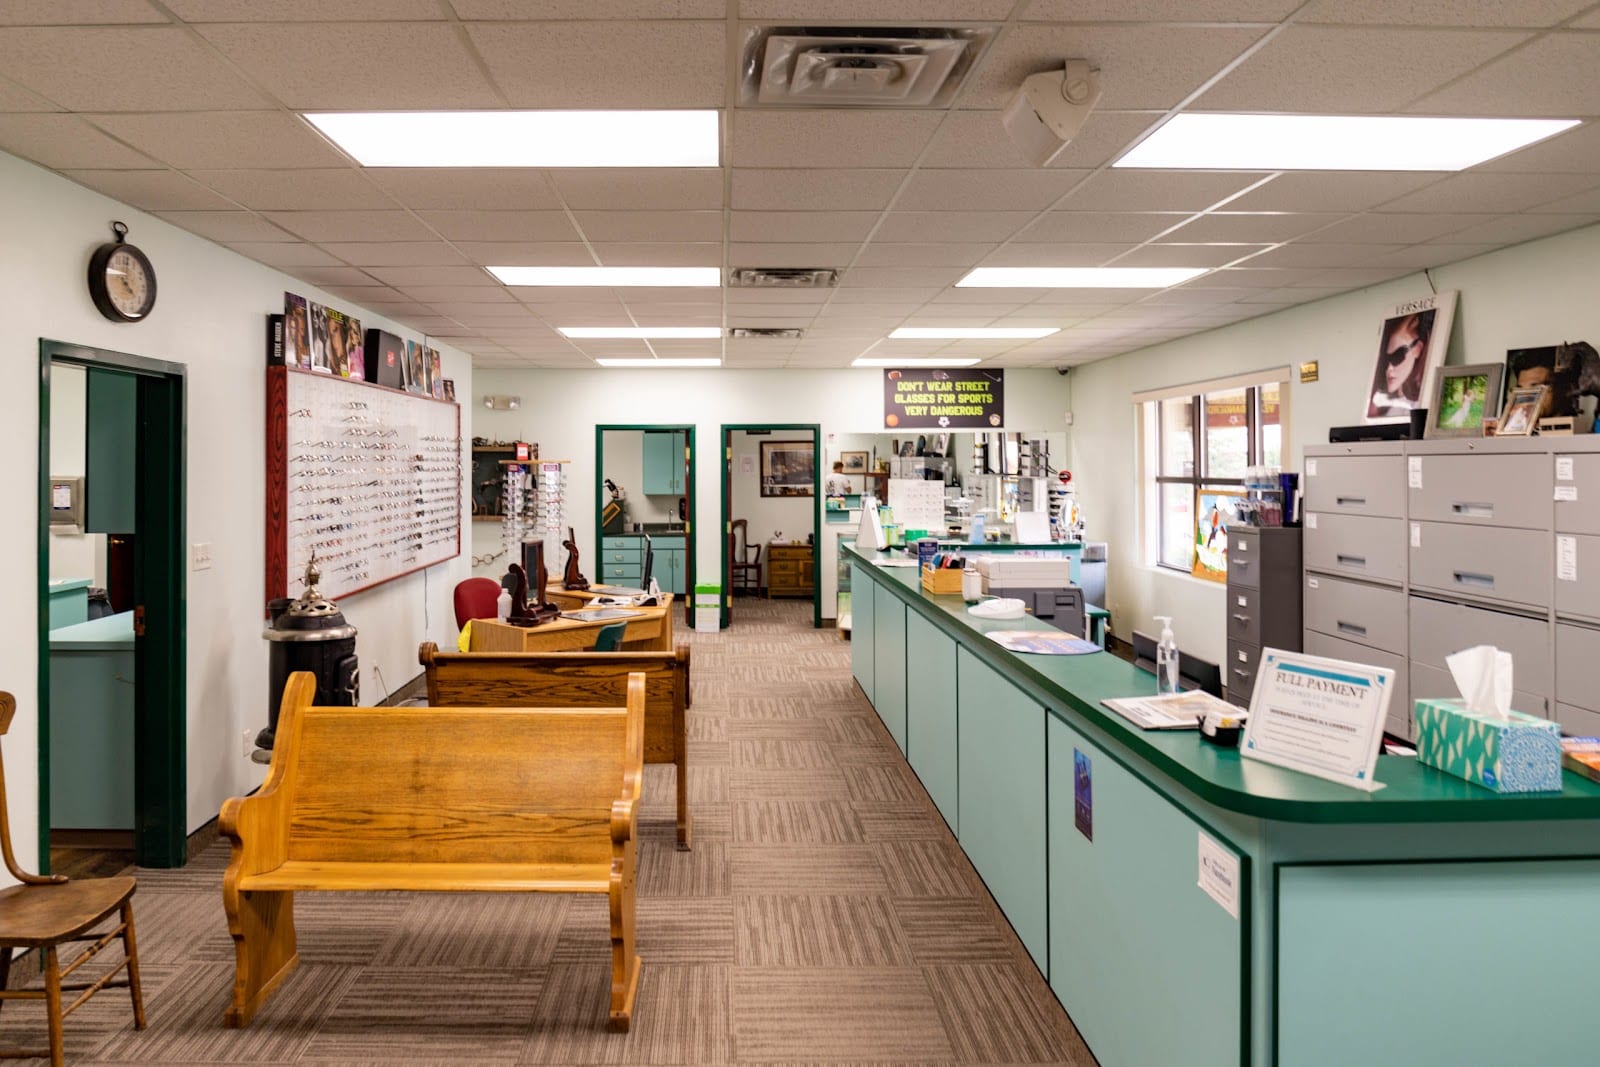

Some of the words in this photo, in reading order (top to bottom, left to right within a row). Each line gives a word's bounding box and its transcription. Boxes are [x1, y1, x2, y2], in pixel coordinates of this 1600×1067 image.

[1396, 297, 1437, 315] VERSACE
[897, 381, 923, 391] DON'T
[926, 381, 952, 391] WEAR
[955, 381, 990, 391] STREET
[894, 393, 935, 404] GLASSES
[937, 393, 956, 404] FOR
[958, 393, 993, 404] SPORTS
[904, 405, 928, 416] VERY
[930, 405, 983, 416] DANGEROUS
[1276, 672, 1304, 687] FULL
[1307, 678, 1367, 699] PAYMENT
